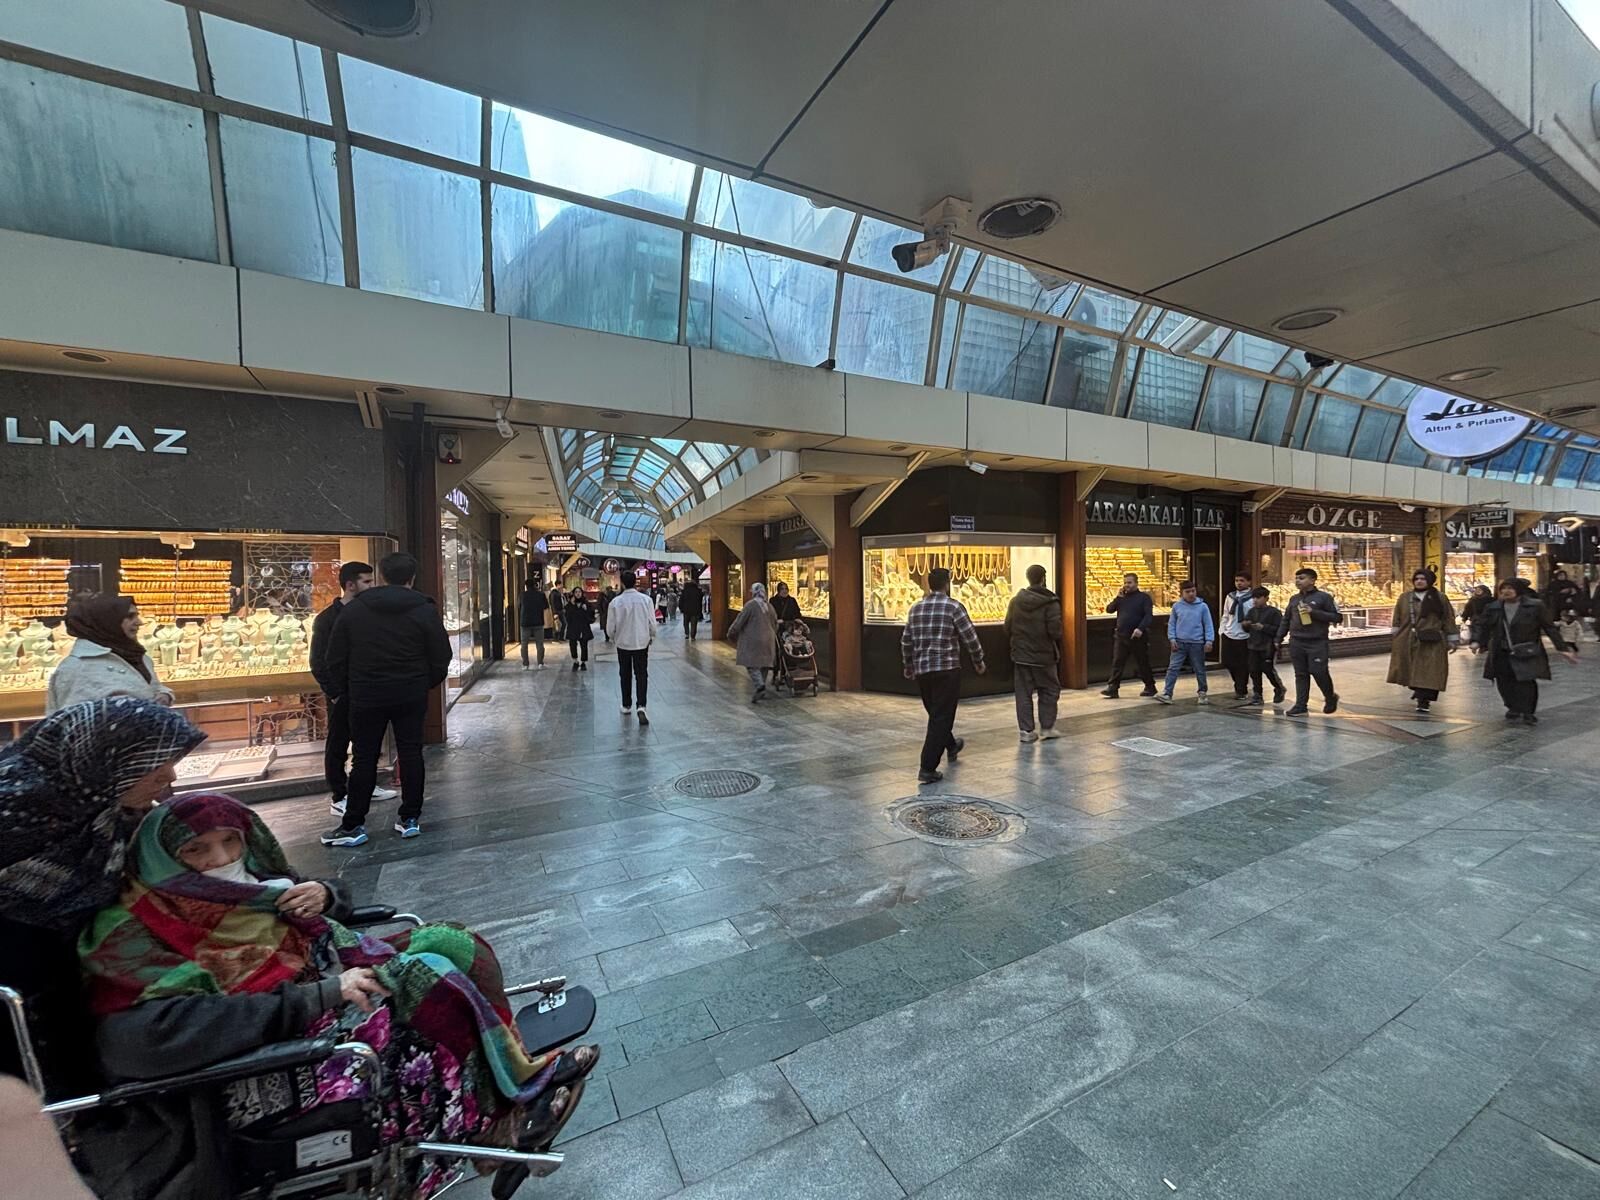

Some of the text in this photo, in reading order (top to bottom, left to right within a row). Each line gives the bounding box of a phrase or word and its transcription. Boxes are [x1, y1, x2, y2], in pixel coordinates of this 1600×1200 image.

[5, 416, 188, 455] LMAZ
[1425, 415, 1516, 434] Altın & Pırlanta
[1307, 503, 1382, 529] ÖZGE
[332, 1133, 349, 1146] CE
